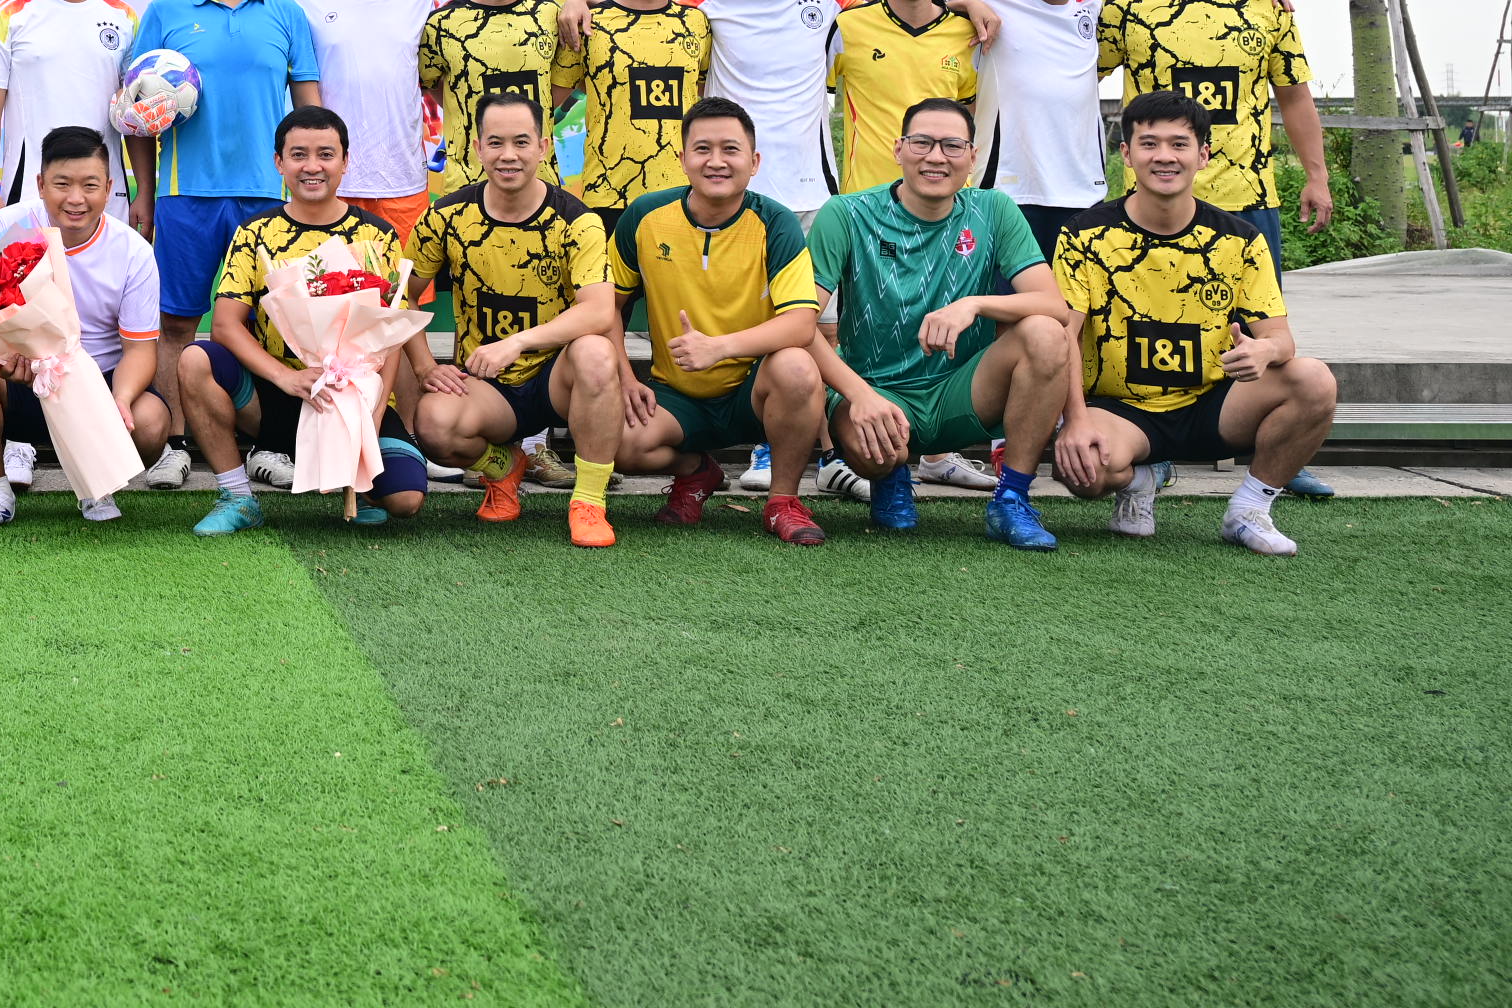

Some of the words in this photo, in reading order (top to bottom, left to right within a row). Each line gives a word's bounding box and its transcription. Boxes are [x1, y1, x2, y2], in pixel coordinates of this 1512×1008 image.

[1242, 31, 1263, 48] BVB
[635, 79, 680, 107] 1&1
[1179, 80, 1234, 110] 1&1
[540, 260, 560, 277] BVB
[1204, 283, 1229, 301] BVB
[482, 306, 531, 340] 1&1
[1134, 336, 1195, 373] 1&1
